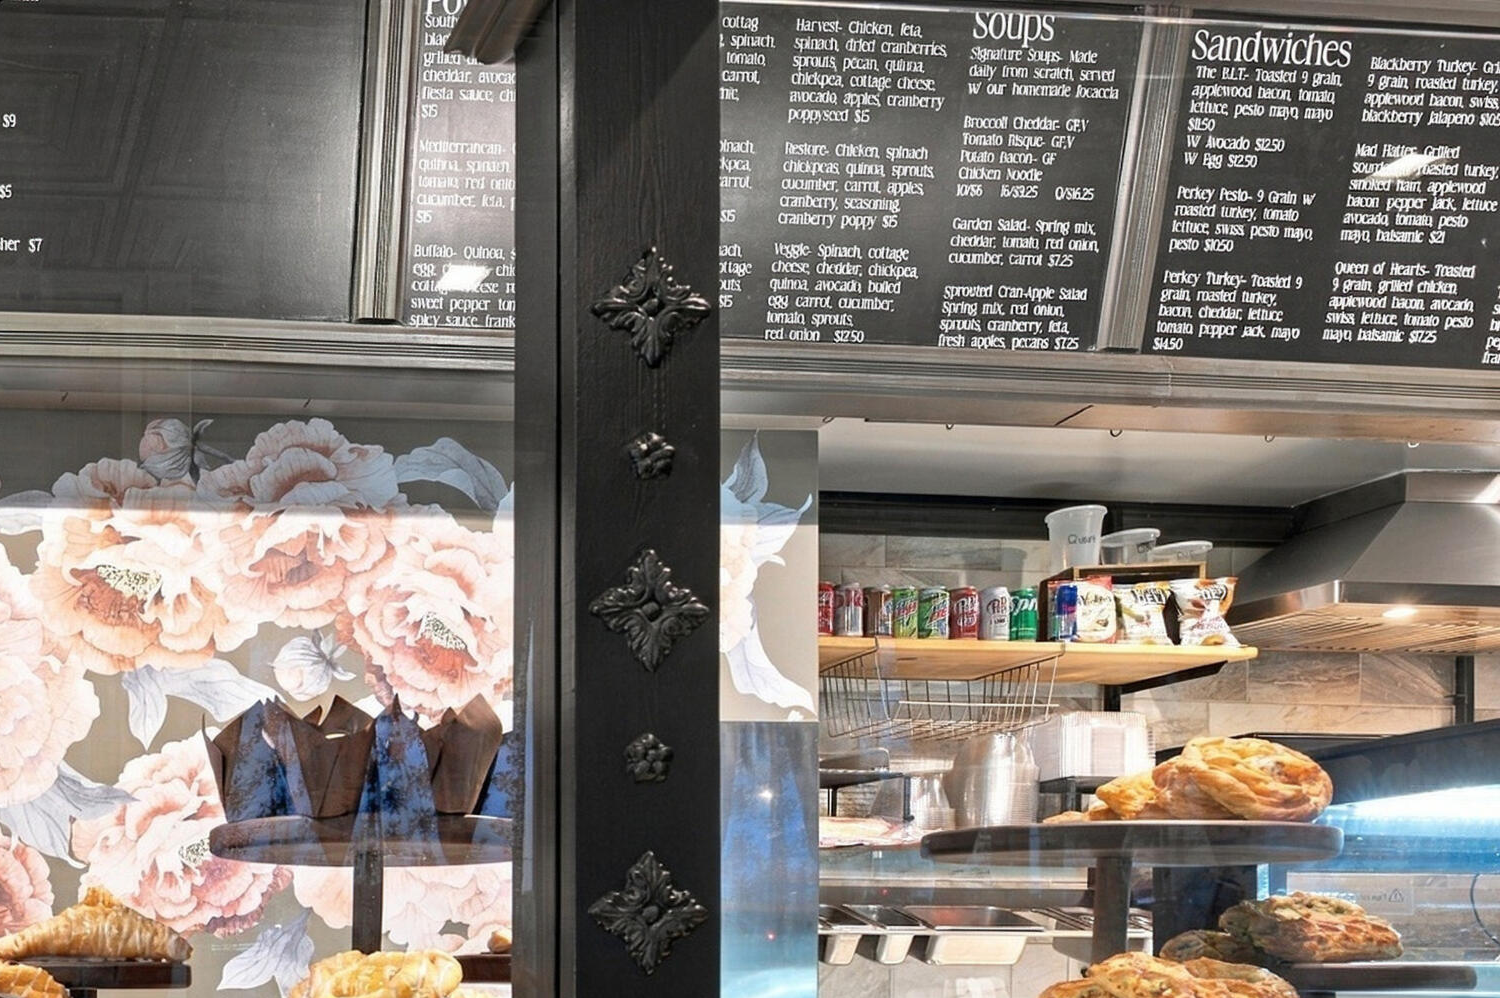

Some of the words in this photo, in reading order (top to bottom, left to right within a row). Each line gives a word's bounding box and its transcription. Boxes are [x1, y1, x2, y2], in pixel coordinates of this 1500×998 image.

[849, 21, 894, 36] Chicken,
[973, 12, 1056, 47] Soups
[970, 47, 1022, 62] Signature
[1070, 50, 1097, 63] Made
[1192, 30, 1351, 67] Sandwiches
[969, 64, 996, 81] daily
[1002, 66, 1028, 77] from
[1080, 69, 1115, 81] served
[1371, 57, 1431, 74] Blackberry
[850, 75, 891, 91] cottage
[1256, 69, 1297, 82] Toasted
[987, 84, 1006, 94] our
[1012, 83, 1071, 97] homemade
[1076, 85, 1118, 99] focaccia
[1192, 84, 1252, 99] applewood
[887, 95, 944, 111] cranberry
[3, 114, 16, 127] $9
[788, 109, 848, 124] poppyseed
[854, 109, 869, 123] $15
[964, 115, 1008, 129] Broccoli
[1362, 109, 1423, 126] blackberry
[1428, 111, 1475, 127] jalapeno
[1206, 135, 1250, 150] Avocado
[886, 146, 928, 161] spinach
[959, 167, 1001, 180] Chicken
[1007, 168, 1043, 181] Noodle
[0, 184, 11, 199] $5
[1177, 186, 1215, 203] Perkey
[1268, 191, 1297, 204] Grain
[1175, 204, 1216, 217] roasted
[1263, 208, 1299, 221] tomato
[778, 212, 836, 228] cranberry
[841, 215, 877, 230] poppy
[953, 218, 992, 230] Garden
[1036, 220, 1070, 235] Spring
[1438, 215, 1468, 229] pesto
[29, 238, 42, 252] $7
[818, 244, 862, 260] Spinach,
[868, 247, 909, 262] cottage
[1009, 254, 1042, 265] carrot
[1335, 262, 1369, 275] Queen
[1373, 262, 1386, 275] of
[1435, 264, 1476, 278] Toasted
[944, 285, 993, 299] Sprouted
[998, 286, 1055, 302] Cran-Apple
[1059, 288, 1087, 300] Salad
[411, 297, 443, 309] sweet
[450, 299, 490, 312] pepper
[765, 328, 783, 339] red
[789, 328, 820, 341] onion
